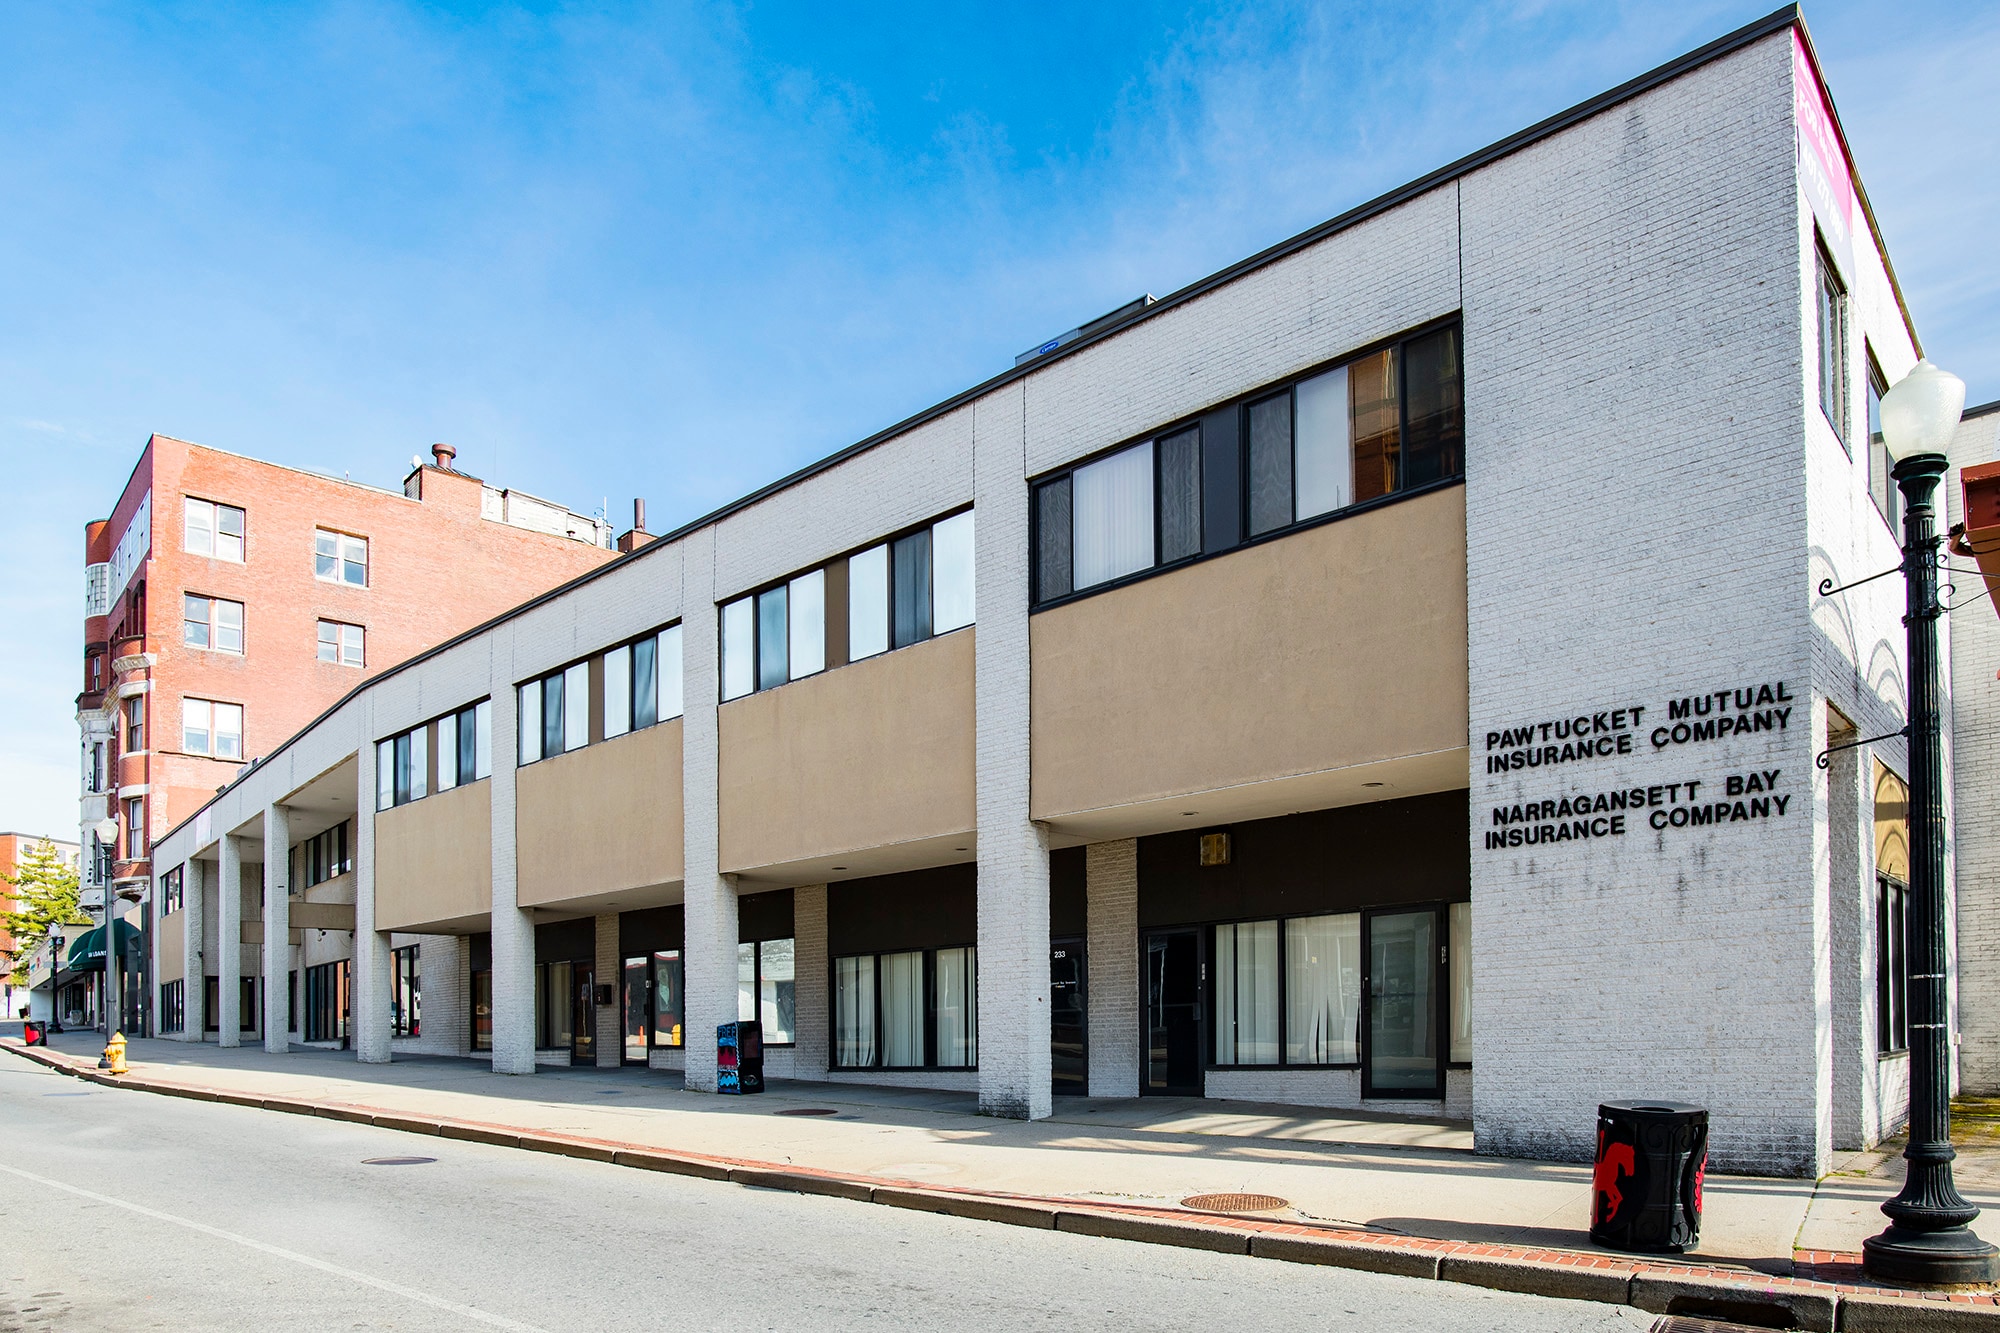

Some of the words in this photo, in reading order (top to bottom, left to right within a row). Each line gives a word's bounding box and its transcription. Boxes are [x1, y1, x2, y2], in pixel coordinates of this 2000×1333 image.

[1486, 706, 1645, 750] PAWTUCKET
[1668, 682, 1793, 721] MUTUAL
[1486, 734, 1632, 774] INSURANCE
[1650, 707, 1793, 748] COMPANY
[1485, 815, 1626, 850] INSURANCE
[1649, 794, 1792, 830] COMPANY
[1492, 781, 1701, 826] NARRAGANSETT
[1726, 769, 1781, 796] BAY
[1054, 950, 1066, 958] 233
[718, 1025, 736, 1038] FREE
